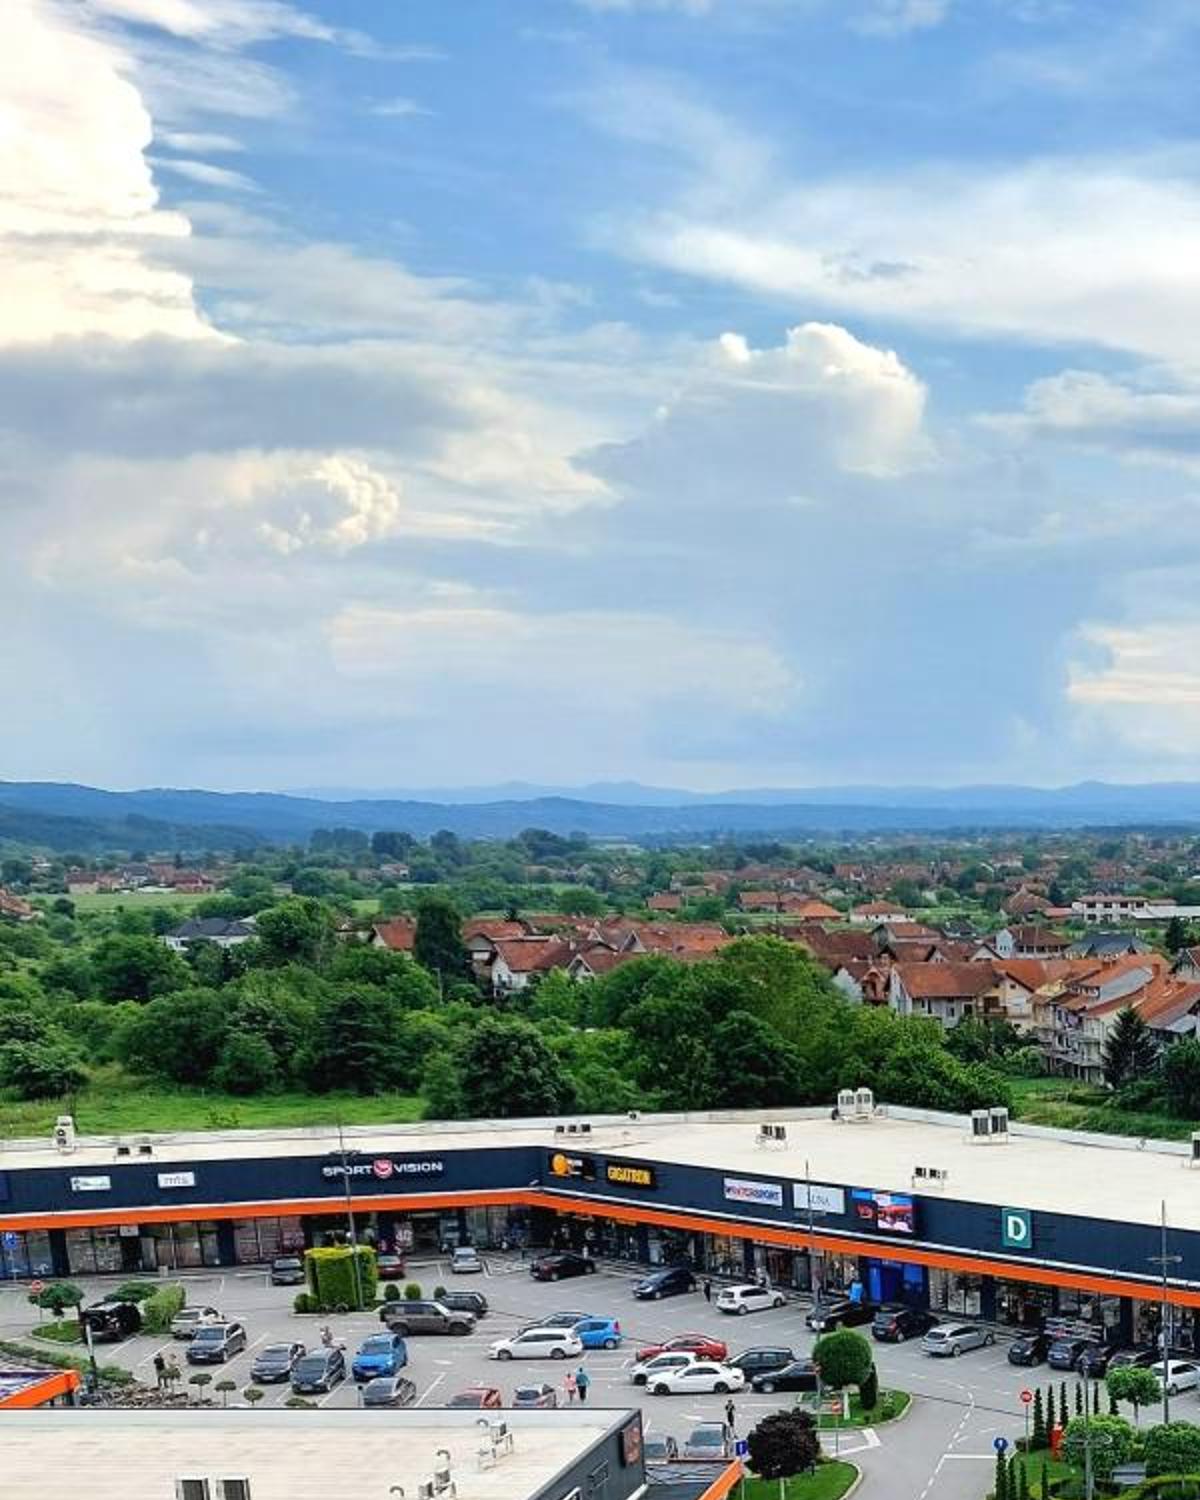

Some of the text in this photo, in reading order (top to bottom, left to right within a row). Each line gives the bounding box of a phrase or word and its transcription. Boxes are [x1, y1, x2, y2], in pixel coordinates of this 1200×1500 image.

[322, 1161, 443, 1177] SPORT VISION
[1007, 1215, 1027, 1241] D
